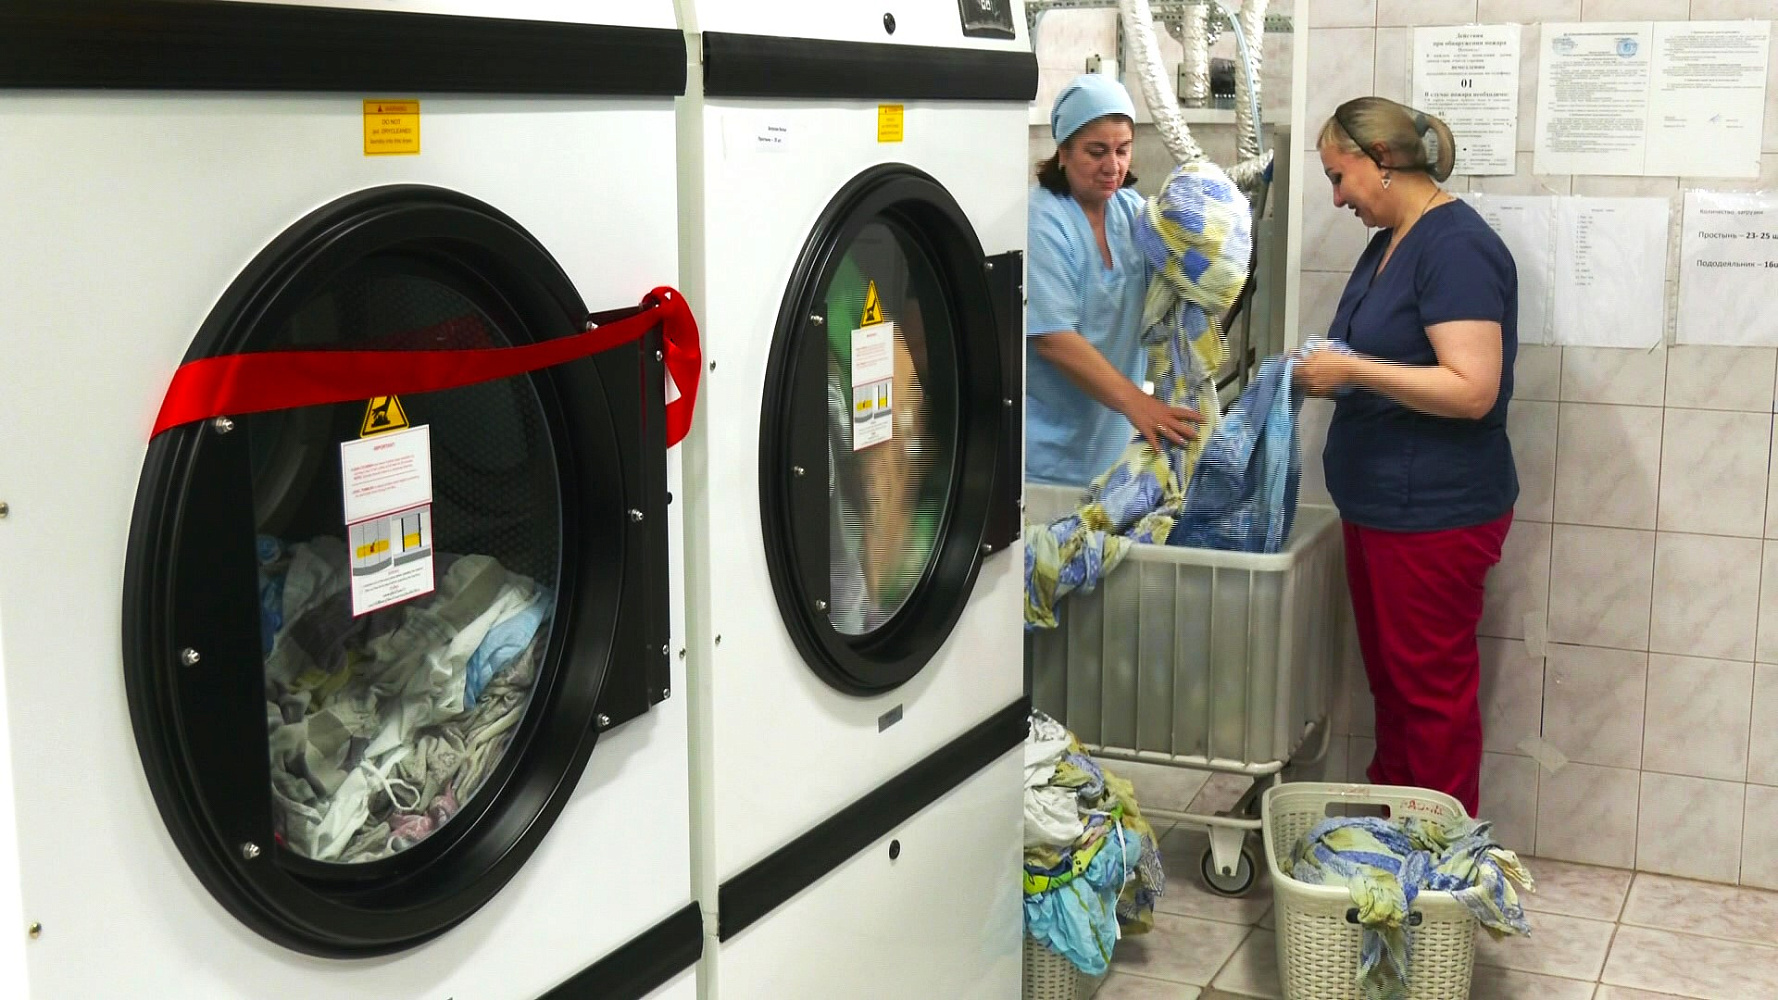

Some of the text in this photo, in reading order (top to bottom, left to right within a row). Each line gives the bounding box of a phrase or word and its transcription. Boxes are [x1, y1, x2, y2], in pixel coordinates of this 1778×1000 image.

[1461, 79, 1472, 88] 01
[1698, 231, 1737, 239] Простынь
[1760, 232, 1770, 240] 25
[1696, 259, 1755, 268] Пододеяльник
